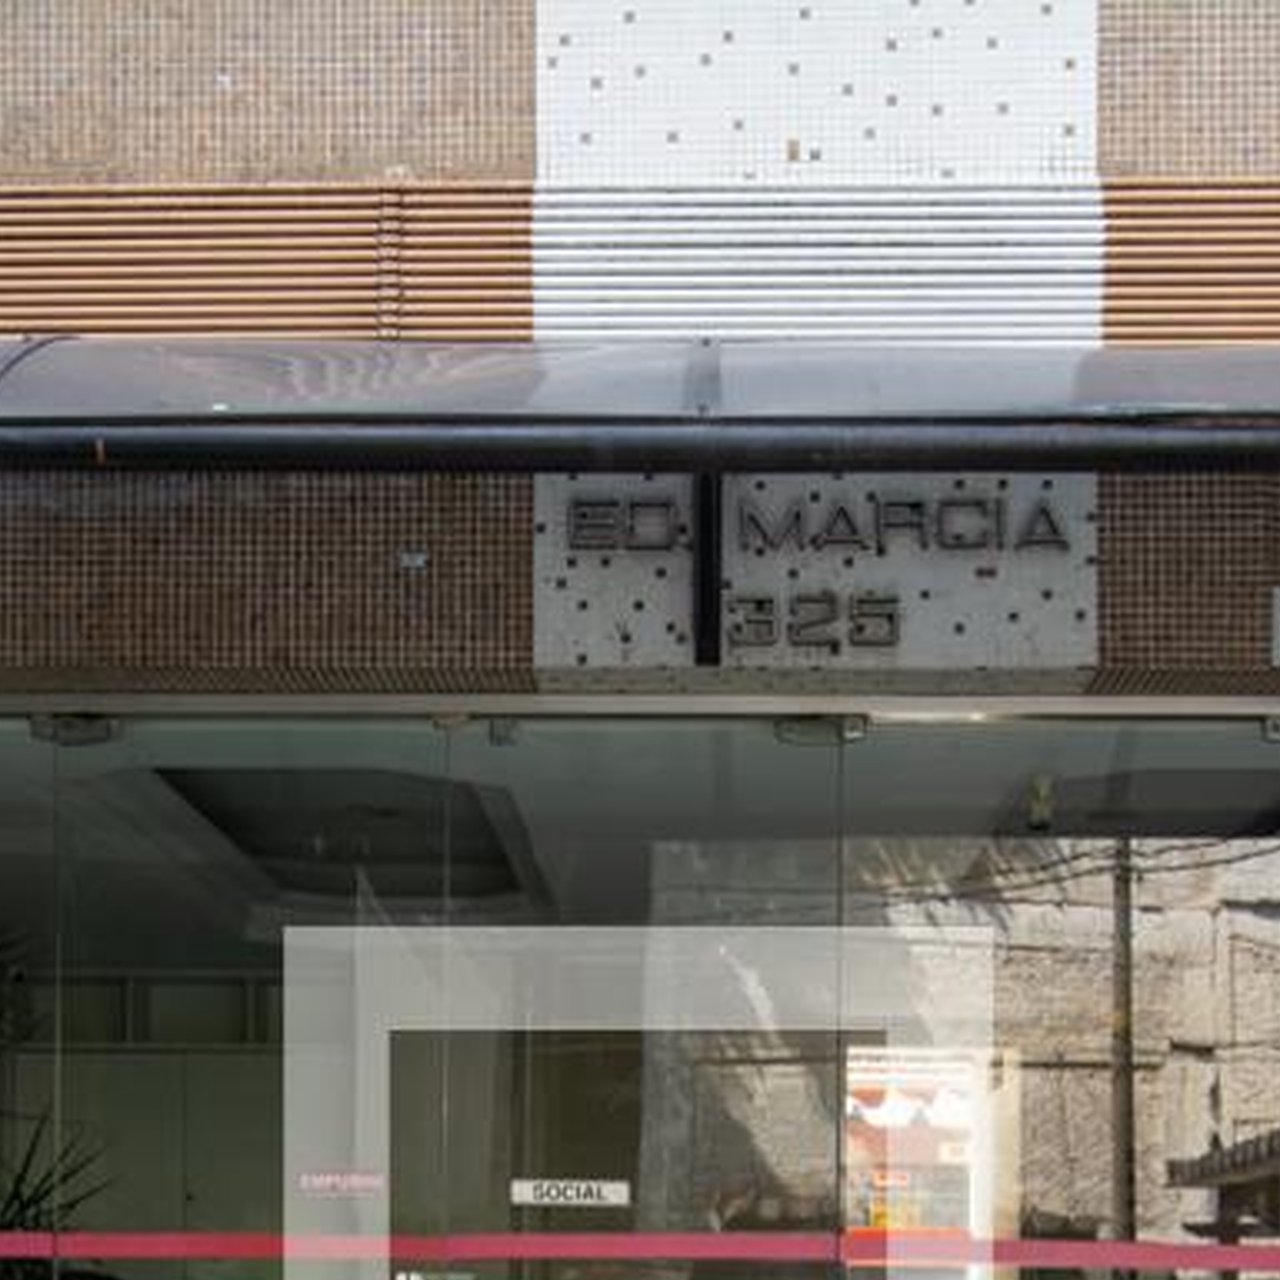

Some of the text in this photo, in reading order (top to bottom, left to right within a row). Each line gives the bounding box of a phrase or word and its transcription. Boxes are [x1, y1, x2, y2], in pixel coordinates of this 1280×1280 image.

[737, 499, 1069, 551] MARCIA
[728, 597, 899, 647] 325
[532, 1183, 608, 1201] SOCIAL
